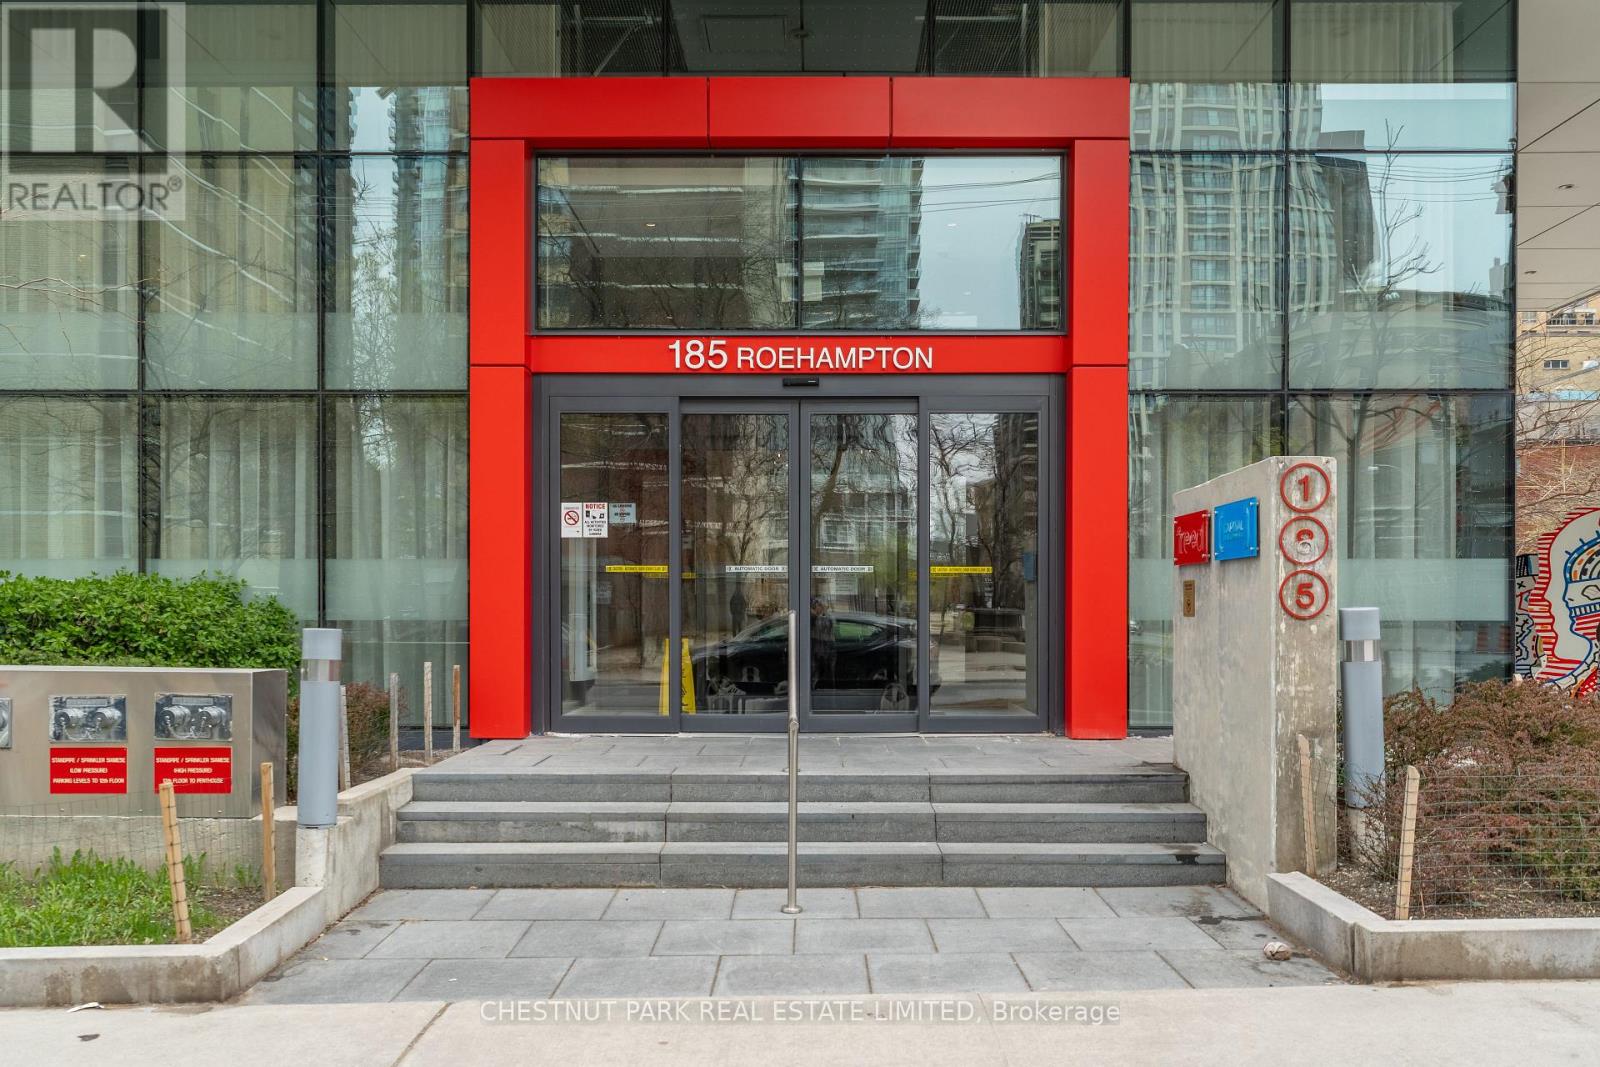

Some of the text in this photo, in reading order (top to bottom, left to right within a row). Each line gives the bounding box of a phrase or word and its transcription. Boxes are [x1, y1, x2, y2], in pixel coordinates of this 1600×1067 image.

[668, 339, 934, 370] 185 ROEHAMPTON
[1297, 474, 1311, 502] 1
[1295, 582, 1315, 610] 5
